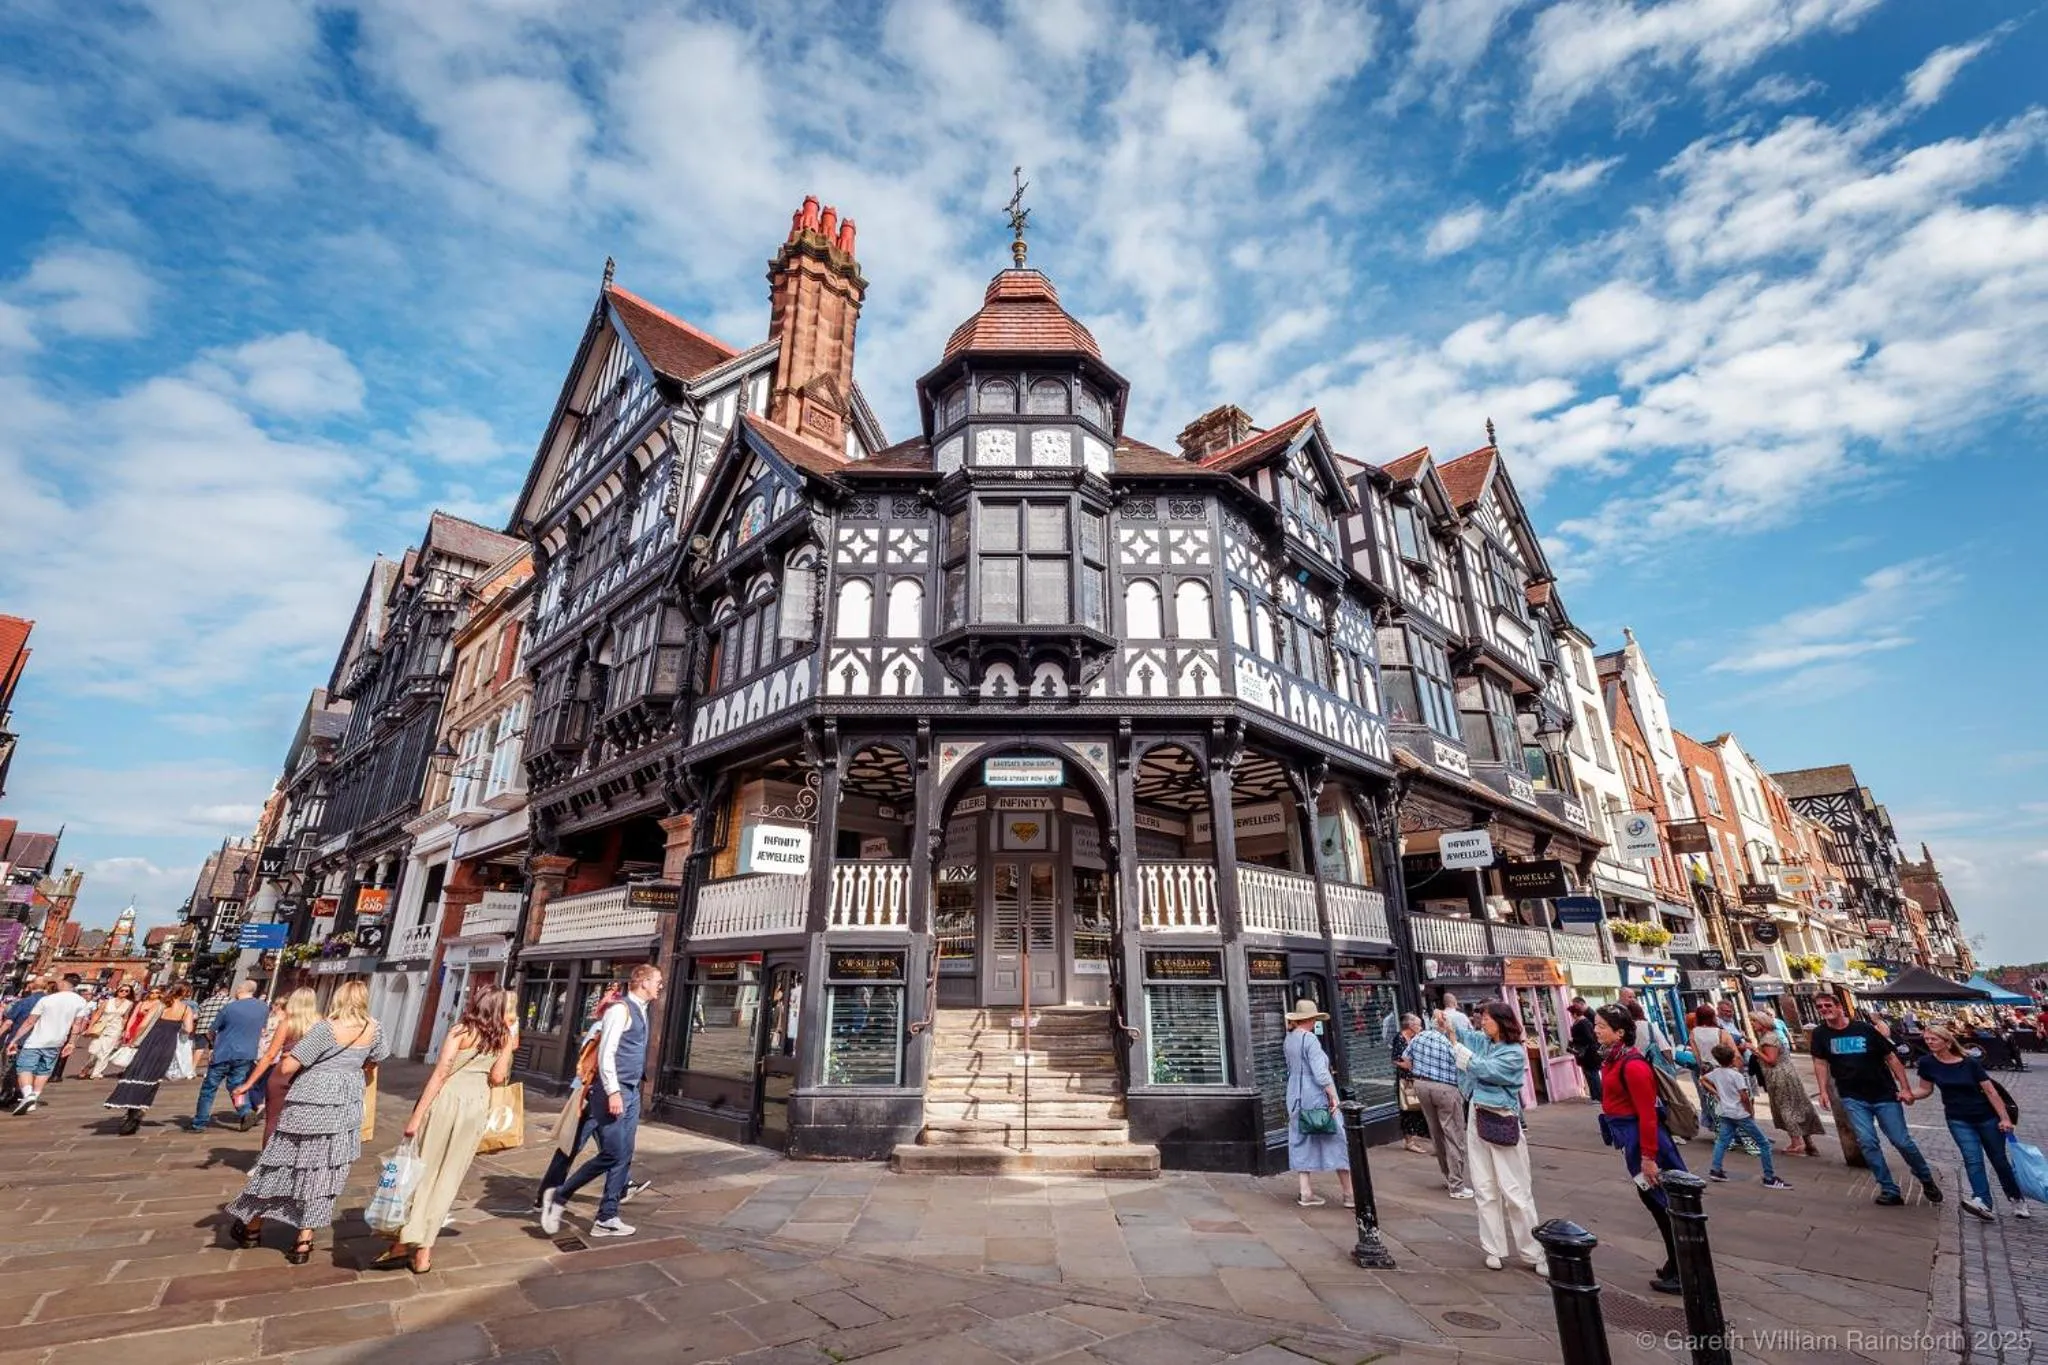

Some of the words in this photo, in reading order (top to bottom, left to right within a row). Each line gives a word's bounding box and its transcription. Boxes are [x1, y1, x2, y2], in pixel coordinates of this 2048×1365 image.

[1000, 798, 1048, 808] INFINITY
[1236, 812, 1281, 828] EWELLERS
[763, 834, 801, 848] INFINITY
[1447, 838, 1481, 849] INFINITY
[756, 850, 805, 864] JEWELLERS
[1446, 849, 1489, 861] JEWELLERS
[262, 860, 281, 872] W
[1508, 872, 1556, 883] POWELLS
